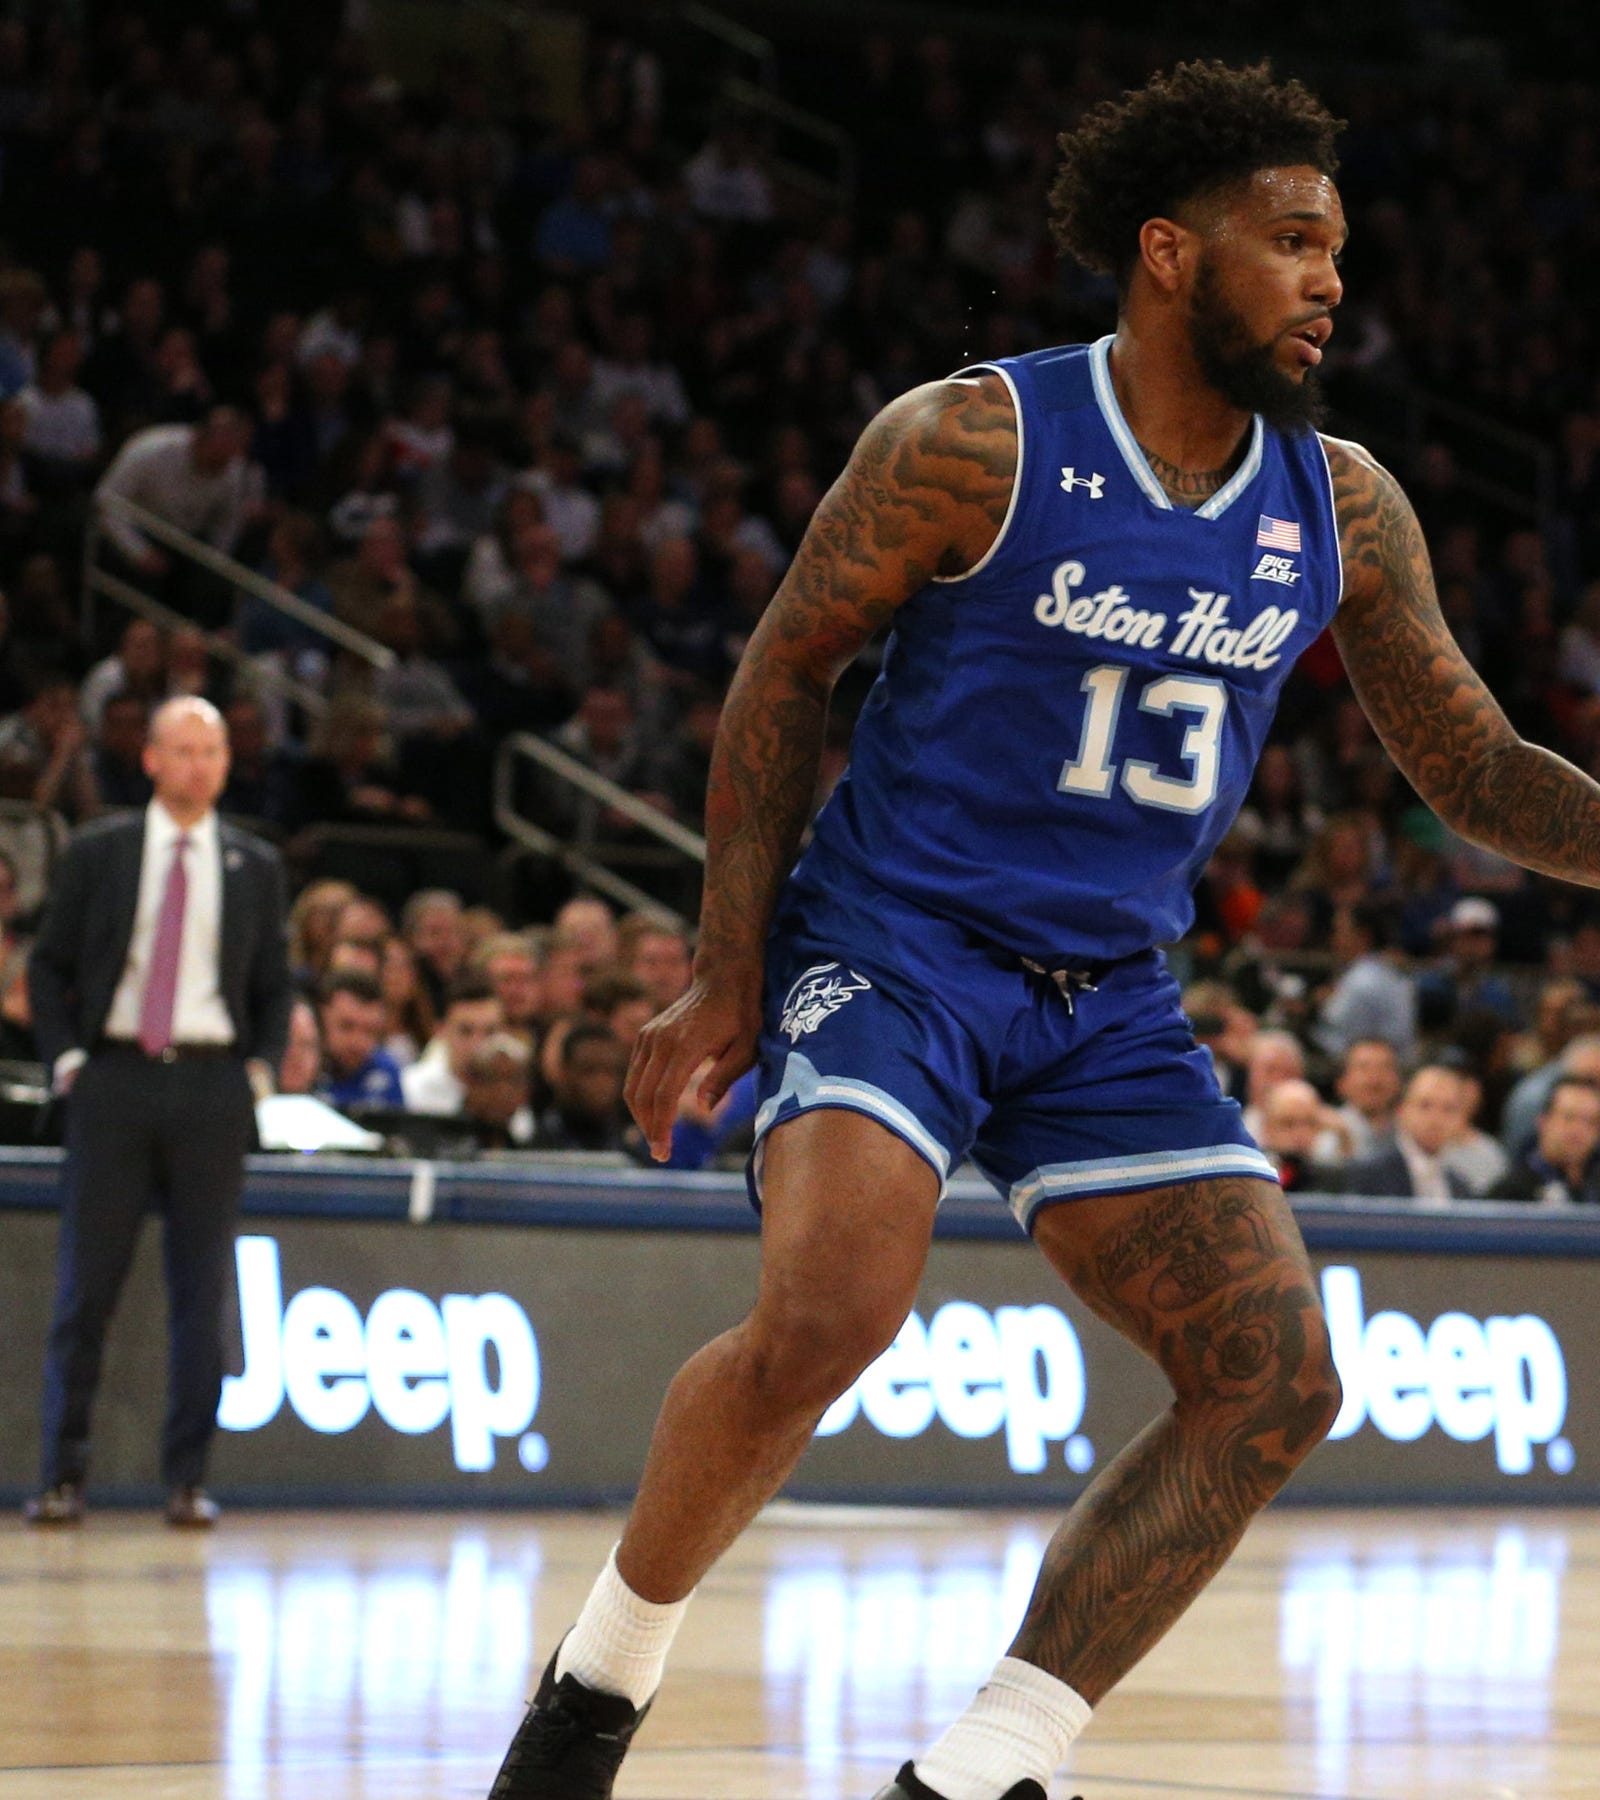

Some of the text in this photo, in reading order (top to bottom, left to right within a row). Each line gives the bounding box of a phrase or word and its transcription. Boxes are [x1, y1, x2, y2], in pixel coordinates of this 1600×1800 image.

[1033, 559, 1299, 671] Seton Hall
[1254, 564, 1301, 583] EAST
[1260, 553, 1295, 571] BIG
[1057, 663, 1229, 815] 13
[812, 1301, 1087, 1474] eep
